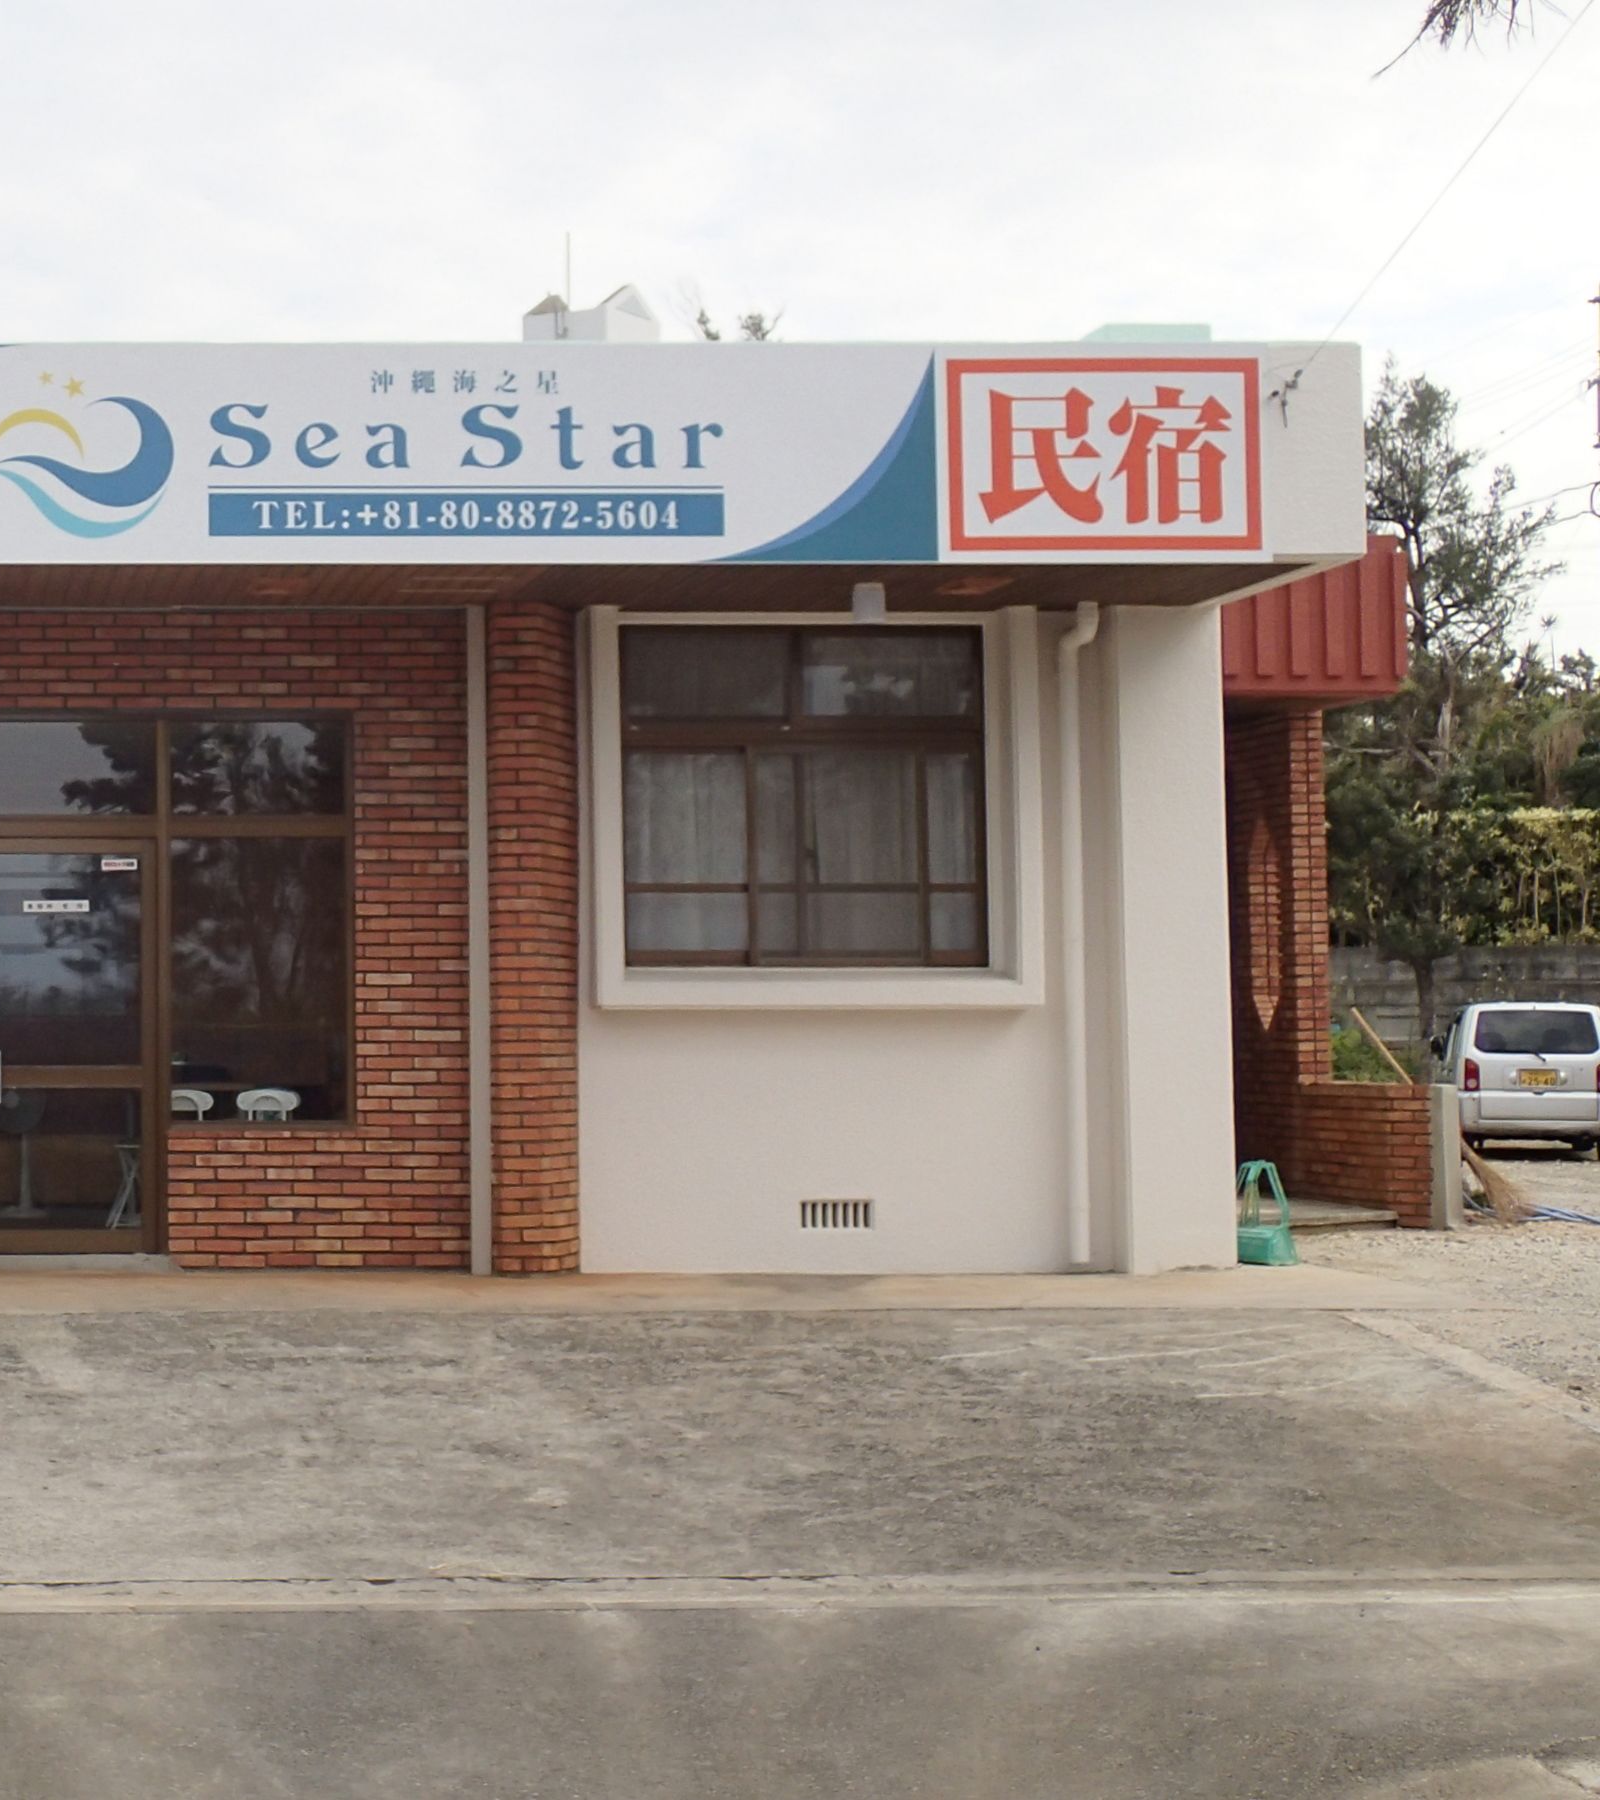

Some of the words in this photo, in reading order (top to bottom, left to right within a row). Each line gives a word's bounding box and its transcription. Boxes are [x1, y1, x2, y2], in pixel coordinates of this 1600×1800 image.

[208, 403, 411, 470] Sea
[459, 403, 724, 471] Star
[978, 386, 1232, 525] 民宿
[252, 501, 680, 531] TEL:+81-80-8872-5604
